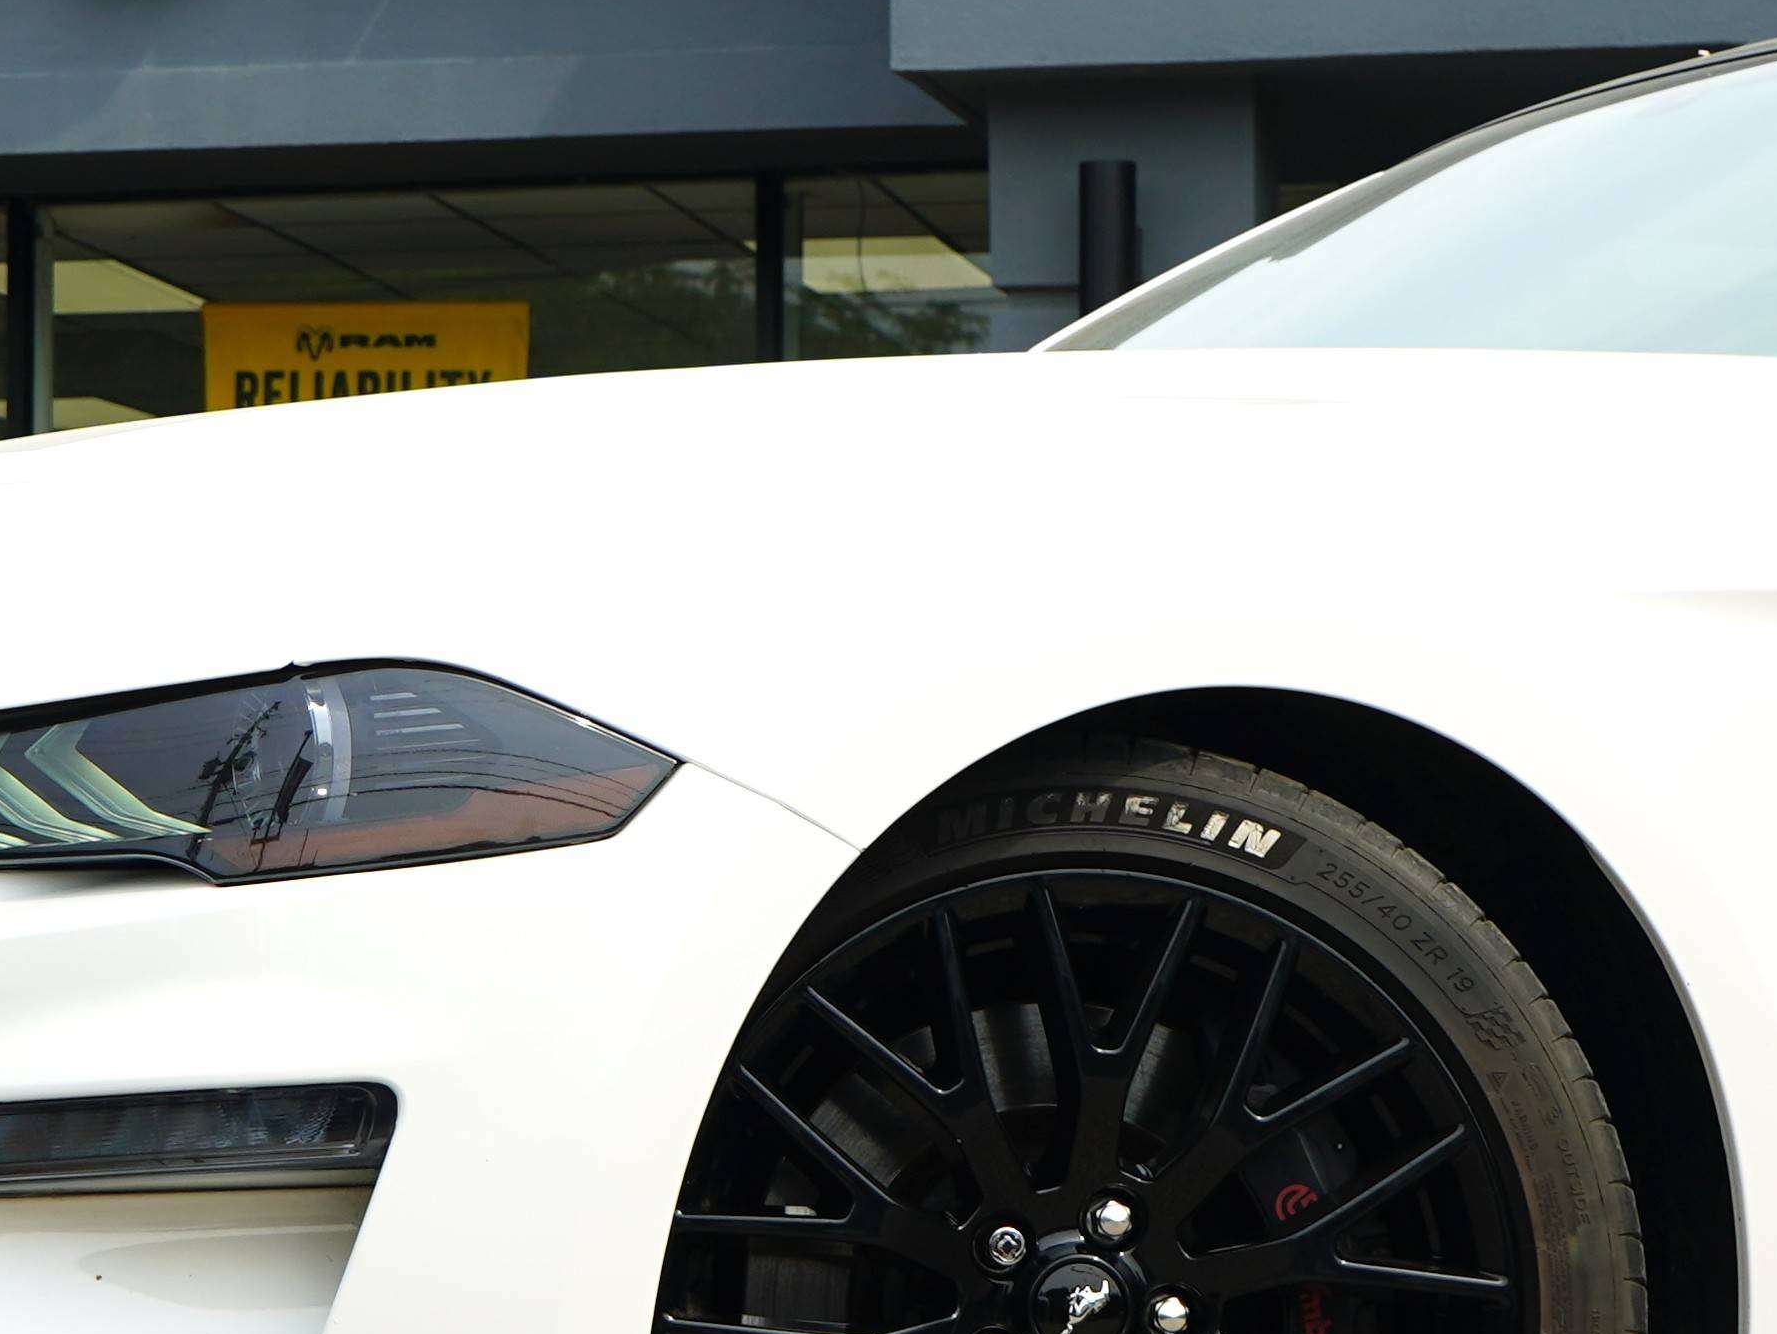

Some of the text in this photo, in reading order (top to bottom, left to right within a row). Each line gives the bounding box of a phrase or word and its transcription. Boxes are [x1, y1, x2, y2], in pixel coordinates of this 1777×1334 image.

[338, 334, 438, 348] RAM
[235, 370, 493, 408] RELIABI
[936, 791, 1282, 860] MICHELIN
[1316, 859, 1475, 995] 255/40 ZR 19
[1554, 1135, 1593, 1228] OUTSIDE
